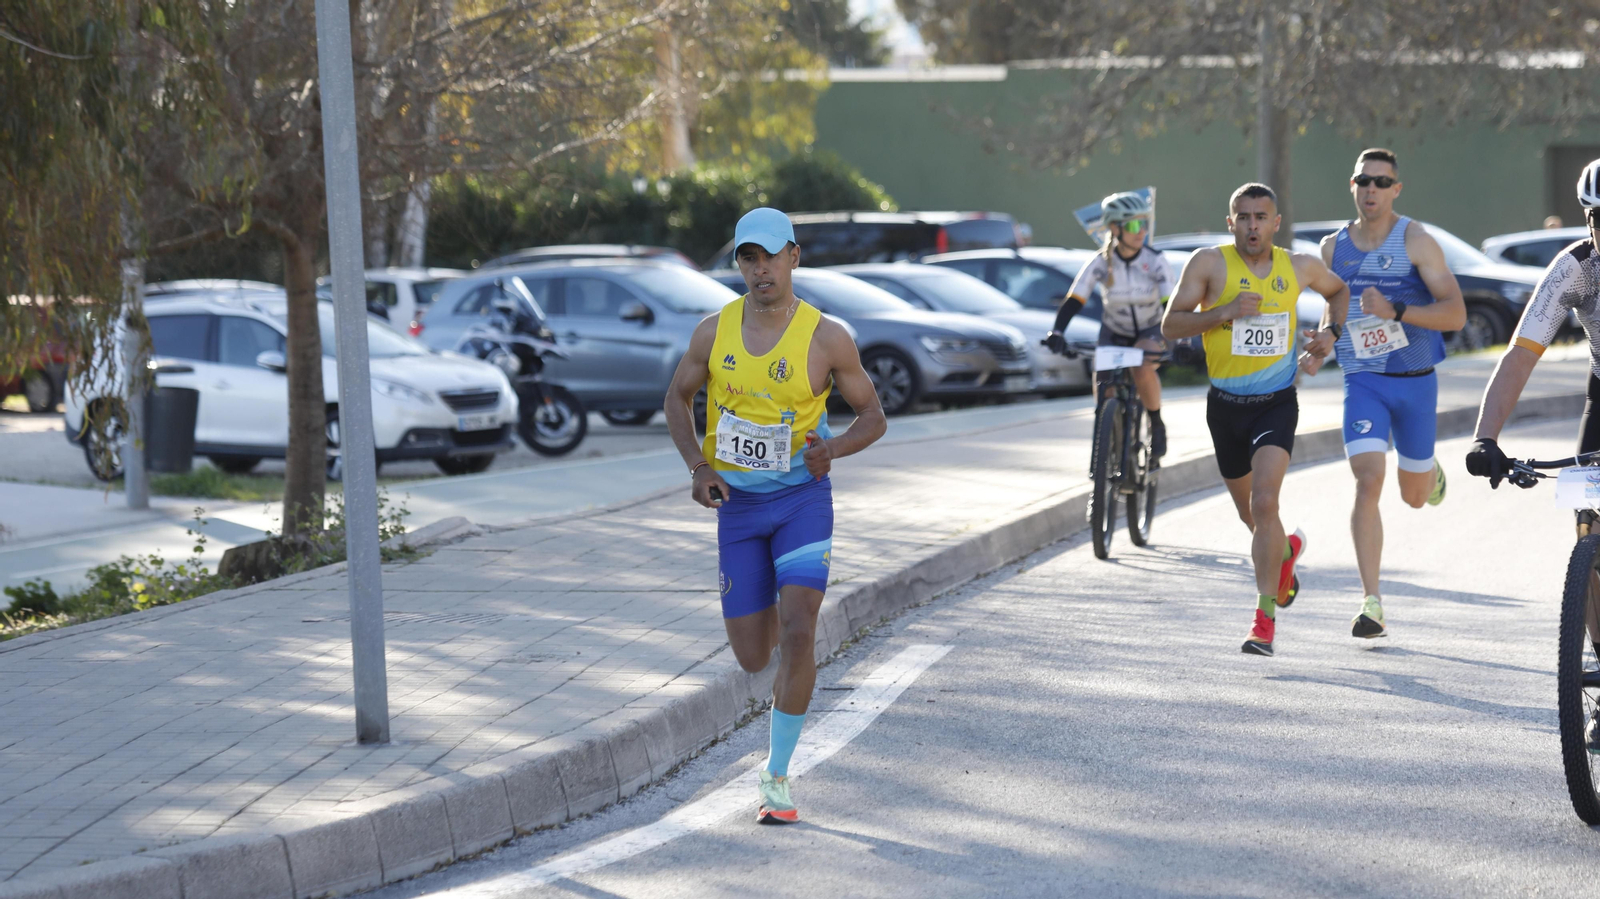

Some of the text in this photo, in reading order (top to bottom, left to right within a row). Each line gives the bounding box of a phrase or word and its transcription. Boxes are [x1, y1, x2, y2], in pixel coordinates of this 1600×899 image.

[1534, 264, 1574, 322] Special Bikes
[1244, 328, 1274, 346] 209
[1361, 328, 1388, 348] 238
[1217, 391, 1275, 404] NIKE PRO
[731, 435, 767, 460] 150
[733, 457, 770, 469] EVOS
